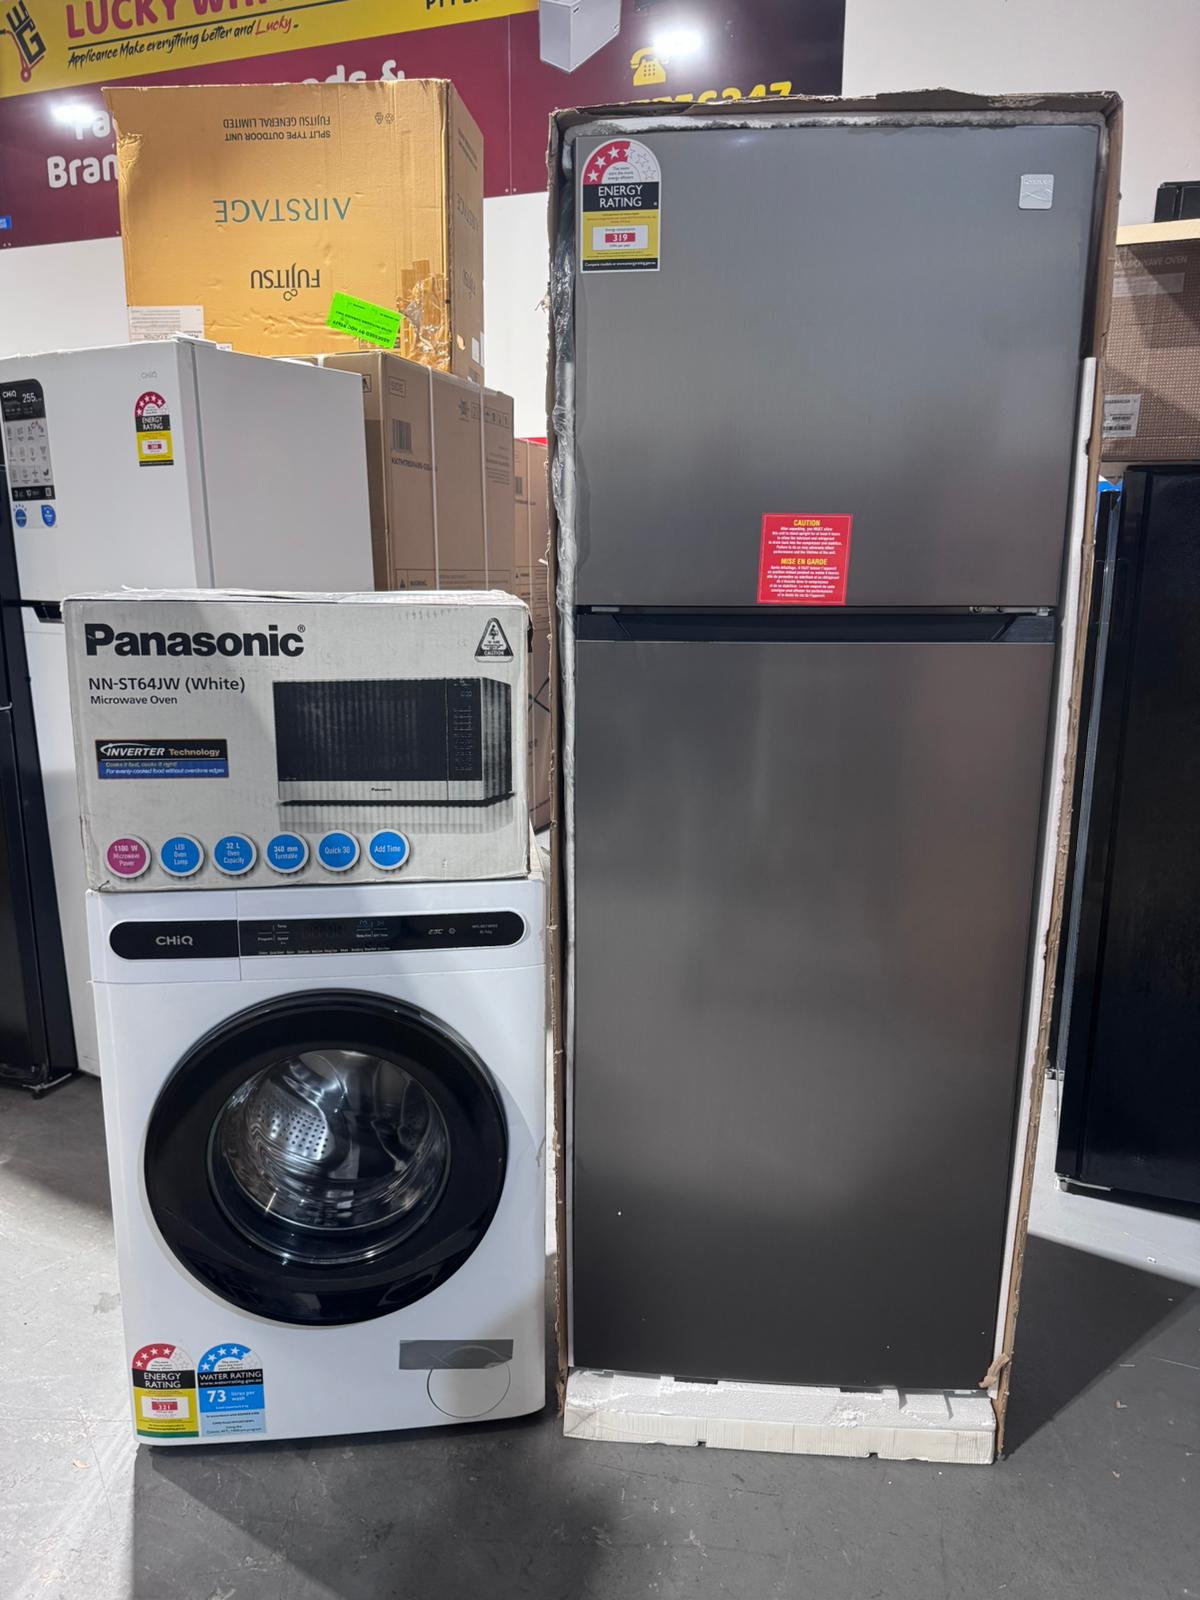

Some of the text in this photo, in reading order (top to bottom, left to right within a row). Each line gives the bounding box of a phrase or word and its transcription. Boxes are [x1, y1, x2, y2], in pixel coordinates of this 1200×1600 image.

[66, 0, 176, 38] LUCKY
[120, 42, 145, 59] Make
[146, 32, 199, 53] everything
[200, 25, 233, 43] better
[234, 20, 257, 38] and
[222, 115, 331, 128] FUJITSU GENERAL LIMITED
[224, 130, 331, 141] SPLIT TYPE OUTDOOR UNIT
[598, 185, 644, 196] ENERGY
[600, 197, 642, 208] RATING
[214, 197, 351, 223] AIRSTAGE
[612, 234, 628, 242] 319
[250, 263, 320, 289] FUJITSU
[84, 623, 304, 657] Panasonic
[89, 677, 246, 694] NN-ST64JW (White)
[90, 695, 178, 704] Microwave Oven
[104, 746, 220, 756] INVERTER Technology
[342, 846, 350, 854] 30
[156, 936, 193, 946] CHiQ
[144, 1372, 182, 1380] ENERGY
[206, 1390, 226, 1403] 73
